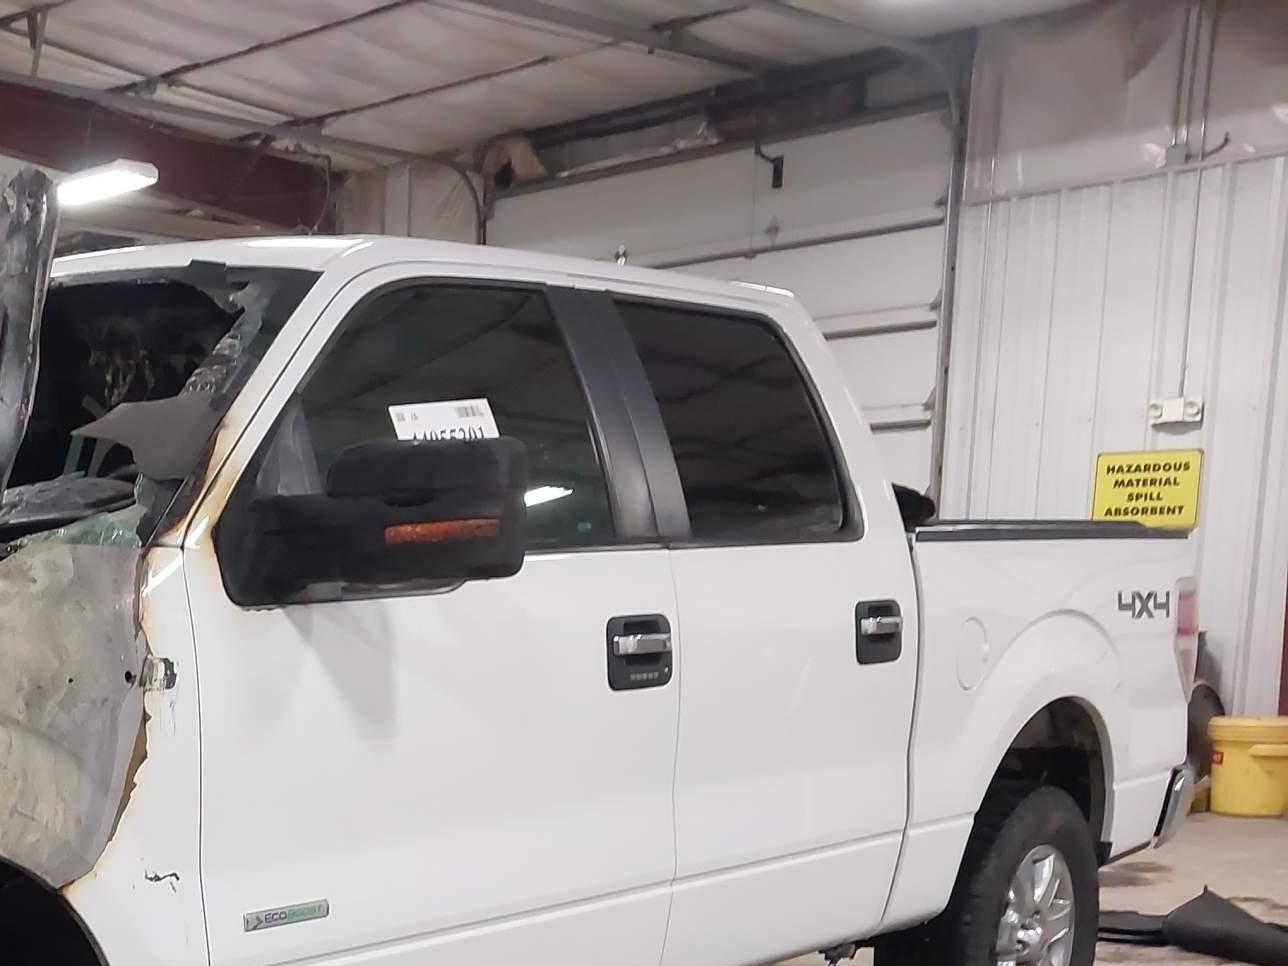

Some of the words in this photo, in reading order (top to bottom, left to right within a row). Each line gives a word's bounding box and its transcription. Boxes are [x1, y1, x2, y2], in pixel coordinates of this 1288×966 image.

[1106, 461, 1190, 475] HAZARDOUS
[1113, 476, 1180, 489] MATERIAL
[1126, 491, 1164, 503] SPILL
[1104, 504, 1185, 517] ABSORBENT
